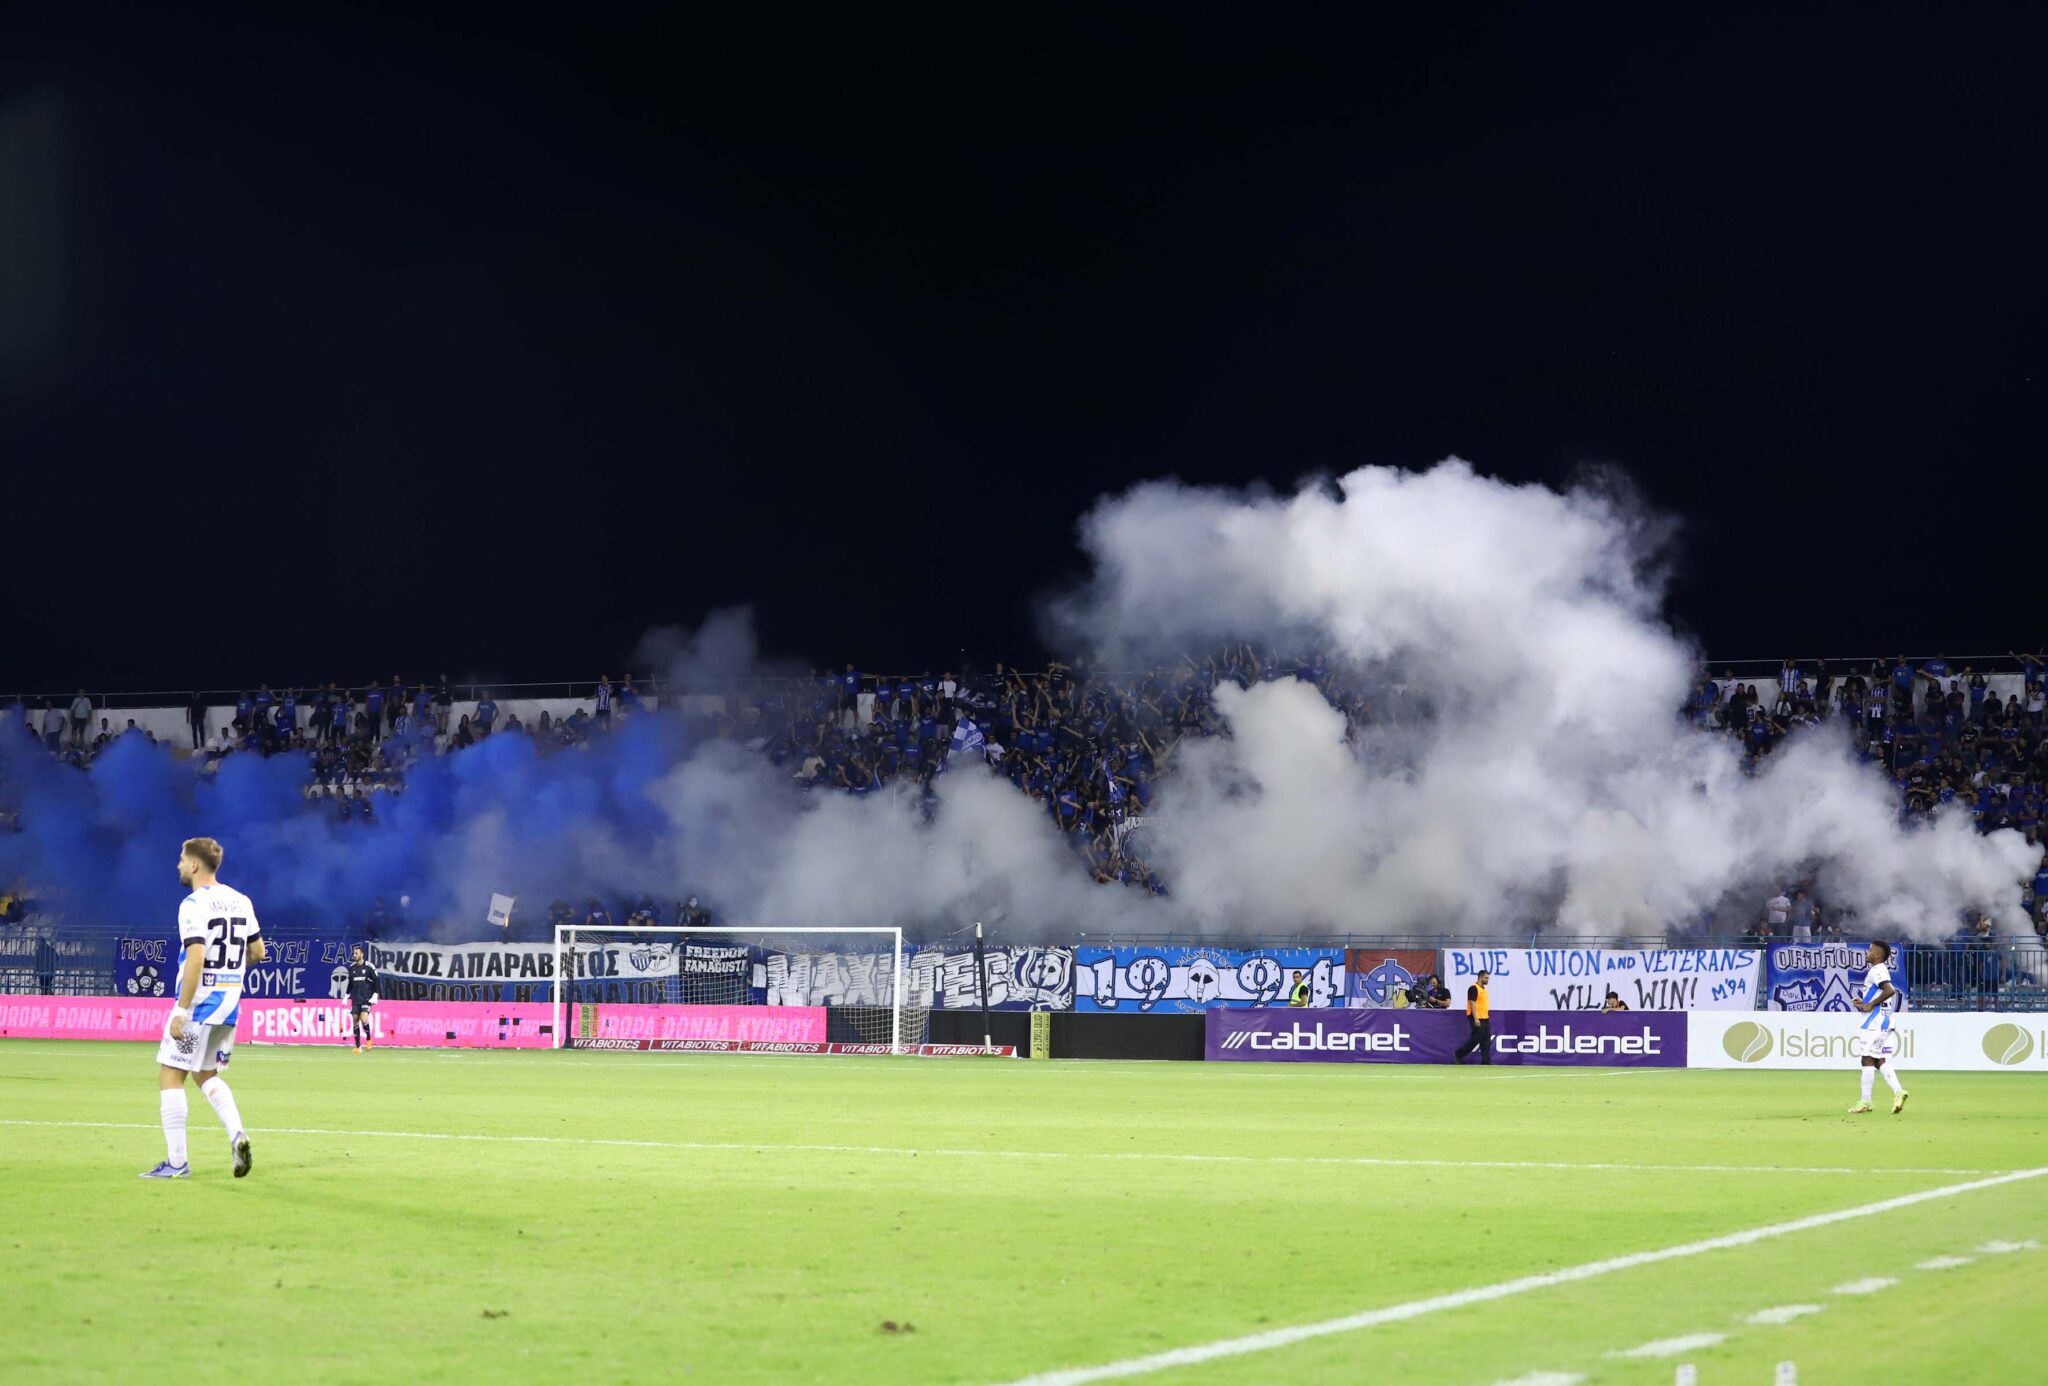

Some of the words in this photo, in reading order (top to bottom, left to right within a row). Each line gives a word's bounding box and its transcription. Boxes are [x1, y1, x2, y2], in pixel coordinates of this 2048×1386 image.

[121, 939, 166, 963] ΠΡΟΣ
[204, 918, 246, 969] 35
[686, 946, 749, 959] FREEDOM
[1452, 951, 1510, 976] BLUE
[1525, 950, 1601, 977] UNION
[1606, 956, 1636, 970] AND
[1639, 950, 1756, 973] VETERANS
[242, 967, 306, 996] ΟΥΜΕ
[1633, 977, 1699, 1010] WIN!
[1711, 977, 1747, 1001] M'94
[0, 1005, 49, 1028] UROPA
[55, 1007, 112, 1031] DONNA
[117, 1008, 171, 1032] ΚΥΠΡ
[573, 1039, 640, 1050] VITABIOTICS
[661, 1040, 730, 1051] VITABIOTICS
[750, 1042, 820, 1052] VITABIOTICS
[841, 1045, 911, 1054] VITABIOTS
[1250, 1022, 1410, 1051] cablenet
[1495, 1024, 1661, 1055] cablenet
